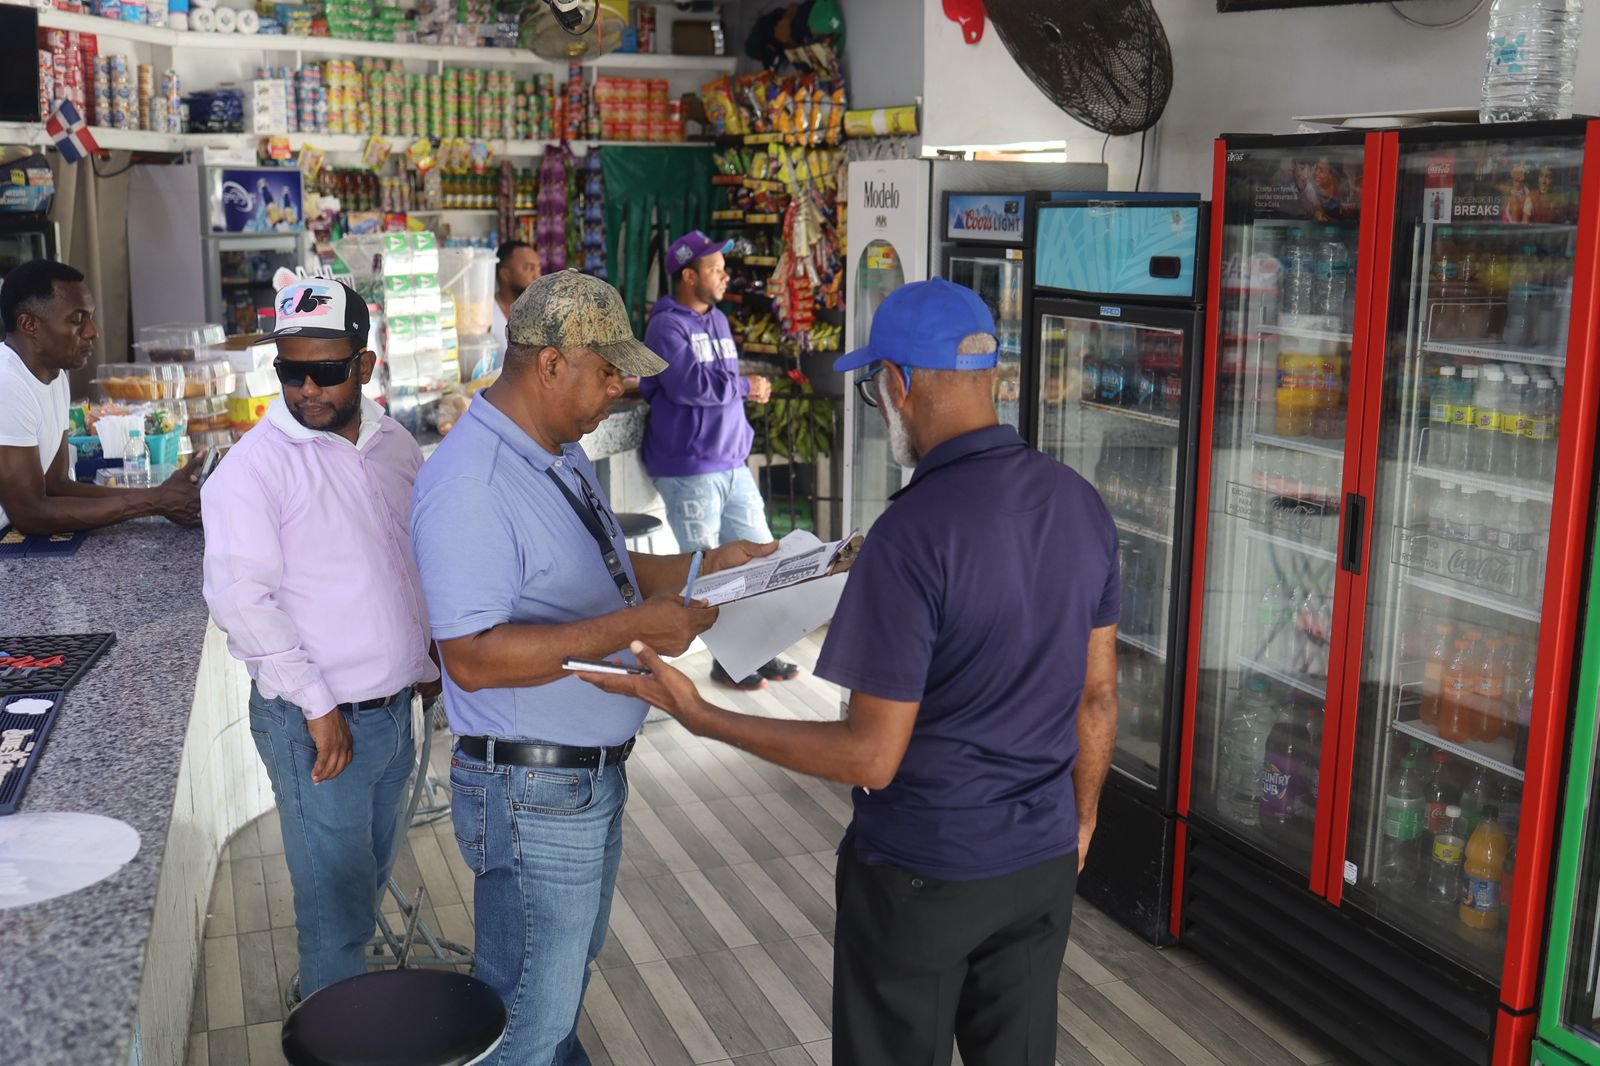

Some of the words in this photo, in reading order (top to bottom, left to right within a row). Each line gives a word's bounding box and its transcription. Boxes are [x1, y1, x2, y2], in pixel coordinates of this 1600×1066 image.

[863, 180, 900, 209] Modelo
[965, 208, 993, 231] Coors
[993, 217, 1021, 232] LIGHT
[1454, 205, 1500, 216] BREAKS
